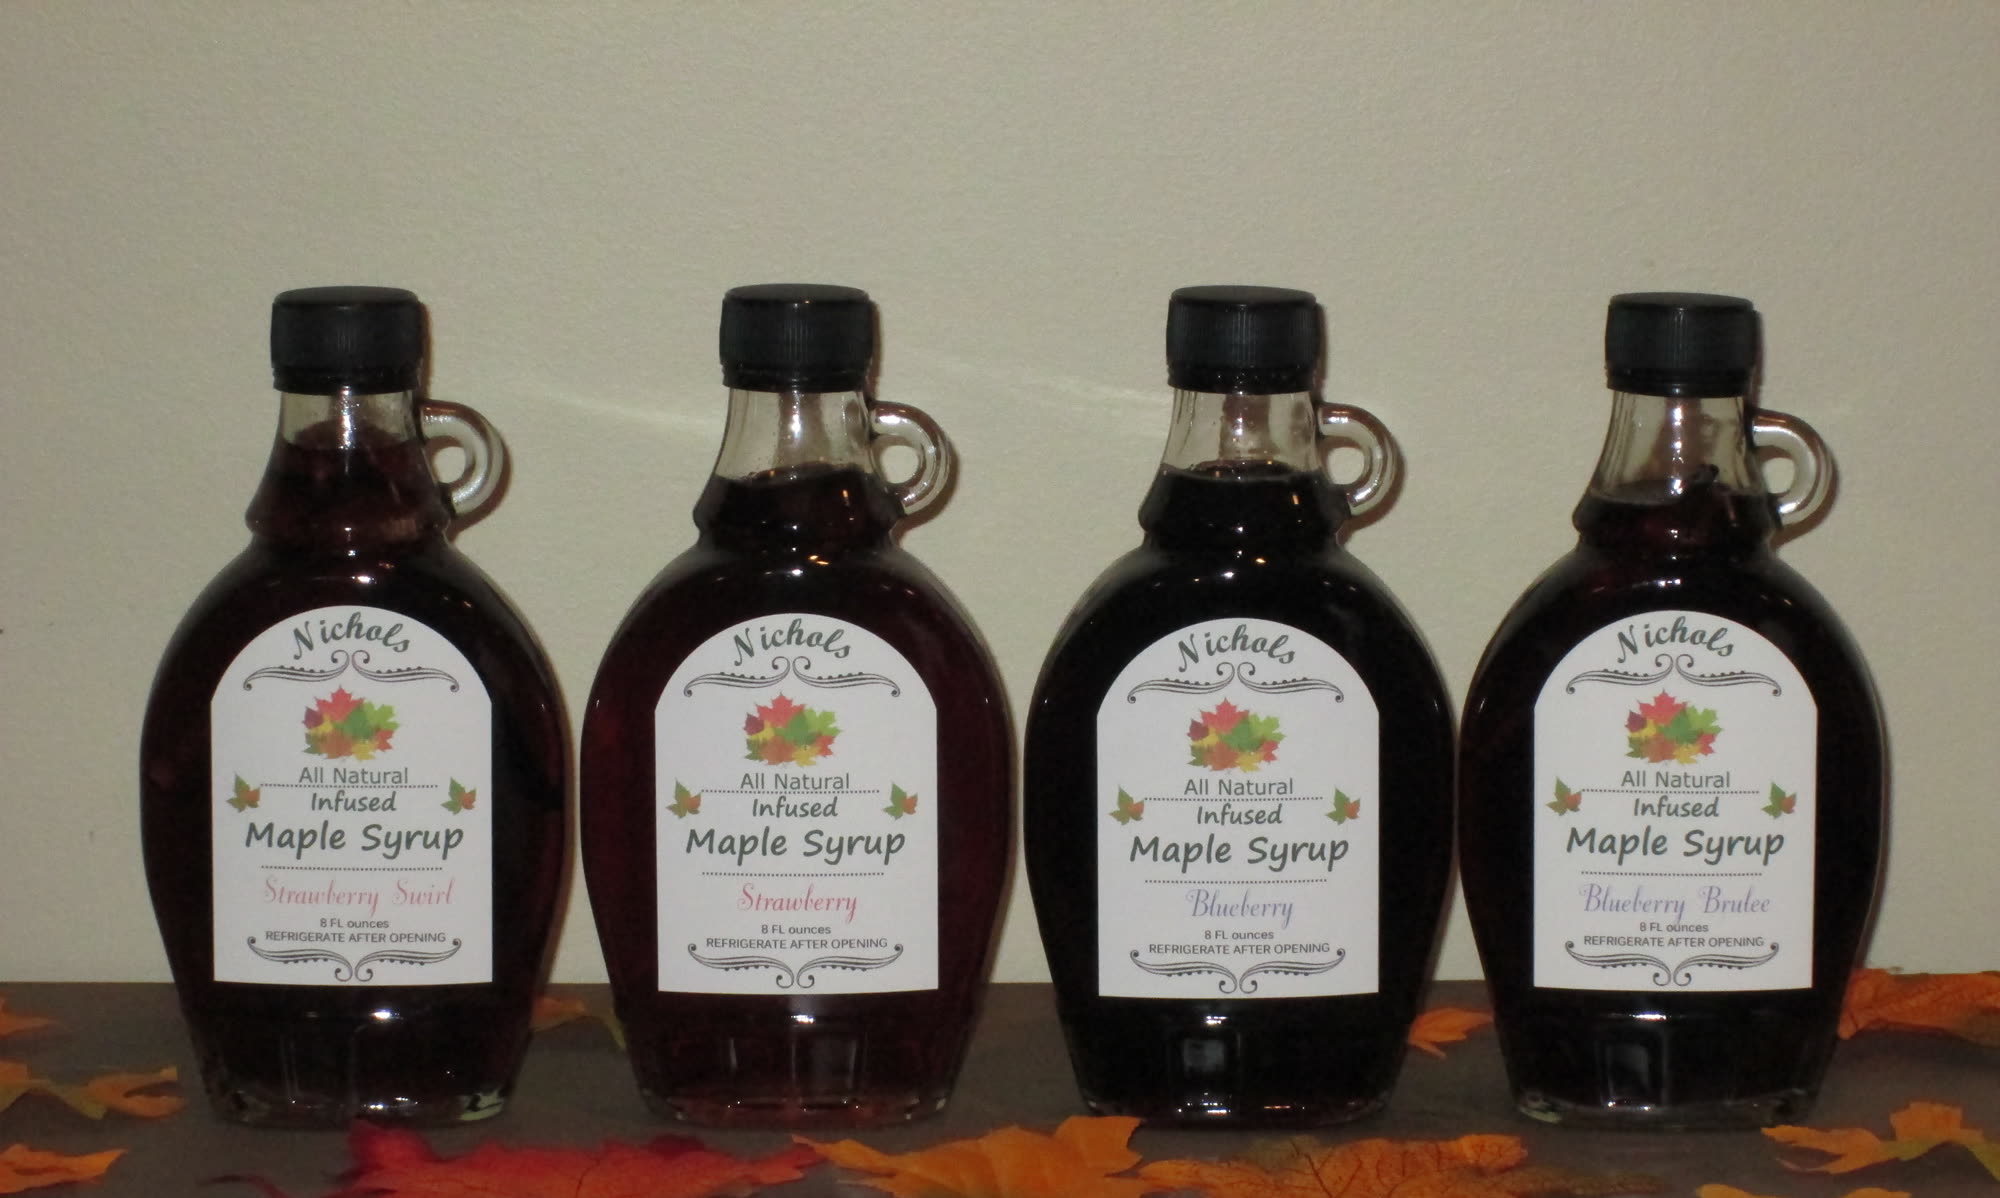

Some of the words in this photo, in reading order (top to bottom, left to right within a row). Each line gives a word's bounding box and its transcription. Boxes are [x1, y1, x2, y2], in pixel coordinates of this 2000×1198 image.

[293, 611, 410, 660] Nichols
[734, 618, 851, 666] Nichols
[1618, 616, 1734, 663] Nichols
[1178, 624, 1295, 673] Nichols
[299, 767, 323, 783] All
[334, 768, 408, 784] Natural
[740, 773, 764, 789] All
[775, 773, 849, 790] Natural
[1184, 779, 1208, 795] All
[1219, 778, 1293, 795] Natural
[1621, 771, 1645, 787] All
[1656, 772, 1730, 788] Natural
[311, 790, 396, 812] Infused
[752, 796, 838, 818] Infused
[1634, 795, 1719, 817] Infused
[1197, 803, 1282, 824] Infused
[245, 820, 346, 860] Maple
[362, 824, 464, 860] Syrup
[686, 826, 787, 866] Maple
[803, 830, 905, 865] Syrup
[1566, 825, 1667, 866] Maple
[1683, 830, 1784, 866] Syrup
[1130, 833, 1232, 873] Maple
[1247, 836, 1348, 872] Syrup
[262, 875, 379, 916] Strawberry
[393, 877, 456, 905] Swirl
[738, 882, 858, 923] Strawberry
[1579, 882, 1686, 923] Blueberry
[1699, 885, 1770, 914] Brulee
[1185, 888, 1294, 929] Blueberry
[320, 918, 327, 927] 8
[331, 919, 343, 928] FL
[347, 920, 389, 928] ounces
[761, 925, 768, 934] 8
[772, 925, 785, 934] FL
[789, 926, 831, 934] ounces
[1640, 922, 1646, 932] 8
[1650, 923, 1662, 932] FL
[1666, 923, 1708, 932] ounces
[266, 931, 345, 942] REFRIGERATE
[348, 933, 386, 942] AFTER
[389, 933, 446, 942] OPENING
[706, 938, 786, 949] REFRIGERATE
[790, 940, 827, 949] AFTER
[831, 939, 887, 949] OPENING
[1205, 930, 1211, 939] 8
[1215, 931, 1228, 939] FL
[1232, 931, 1274, 939] ounces
[1583, 936, 1664, 947] REFRIGERATE
[1667, 937, 1705, 947] AFTER
[1708, 937, 1764, 947] OPENING
[1149, 944, 1230, 955] REFRIGERATE
[1233, 945, 1271, 954] AFTER
[1274, 943, 1330, 954] OPENING
